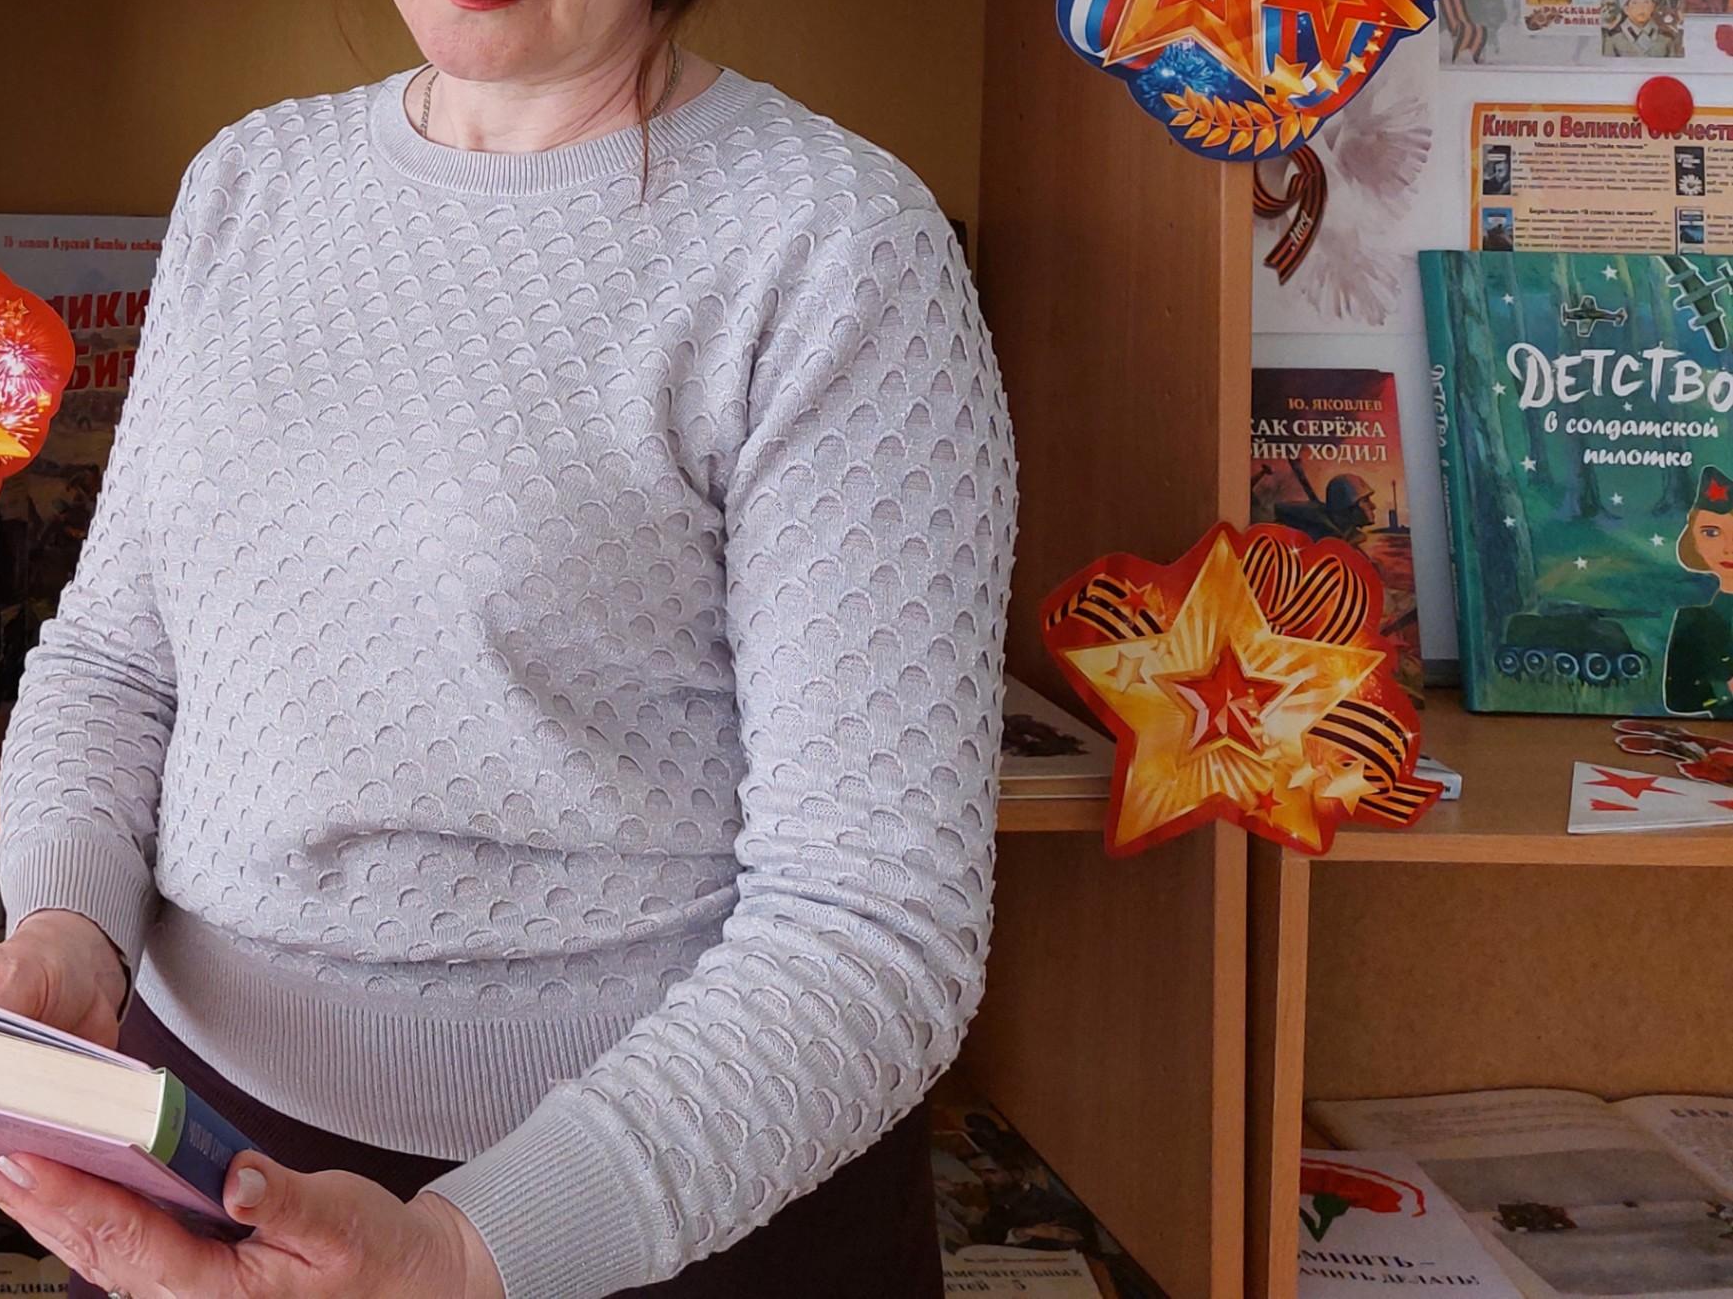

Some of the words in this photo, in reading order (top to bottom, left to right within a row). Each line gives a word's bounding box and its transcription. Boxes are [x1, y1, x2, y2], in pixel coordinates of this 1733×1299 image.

[1482, 114, 1538, 137] Книги
[1543, 120, 1554, 137] о
[1560, 116, 1643, 139] Великой
[1289, 399, 1309, 411] Ю.
[1312, 399, 1383, 411] ЯКОВЛЕВ
[1293, 416, 1386, 437] СЕРЁЖА
[1544, 411, 1558, 433] в
[1565, 417, 1719, 441] солдатской
[1309, 444, 1387, 464] ХОДИЛ
[1583, 448, 1693, 470] пилотке
